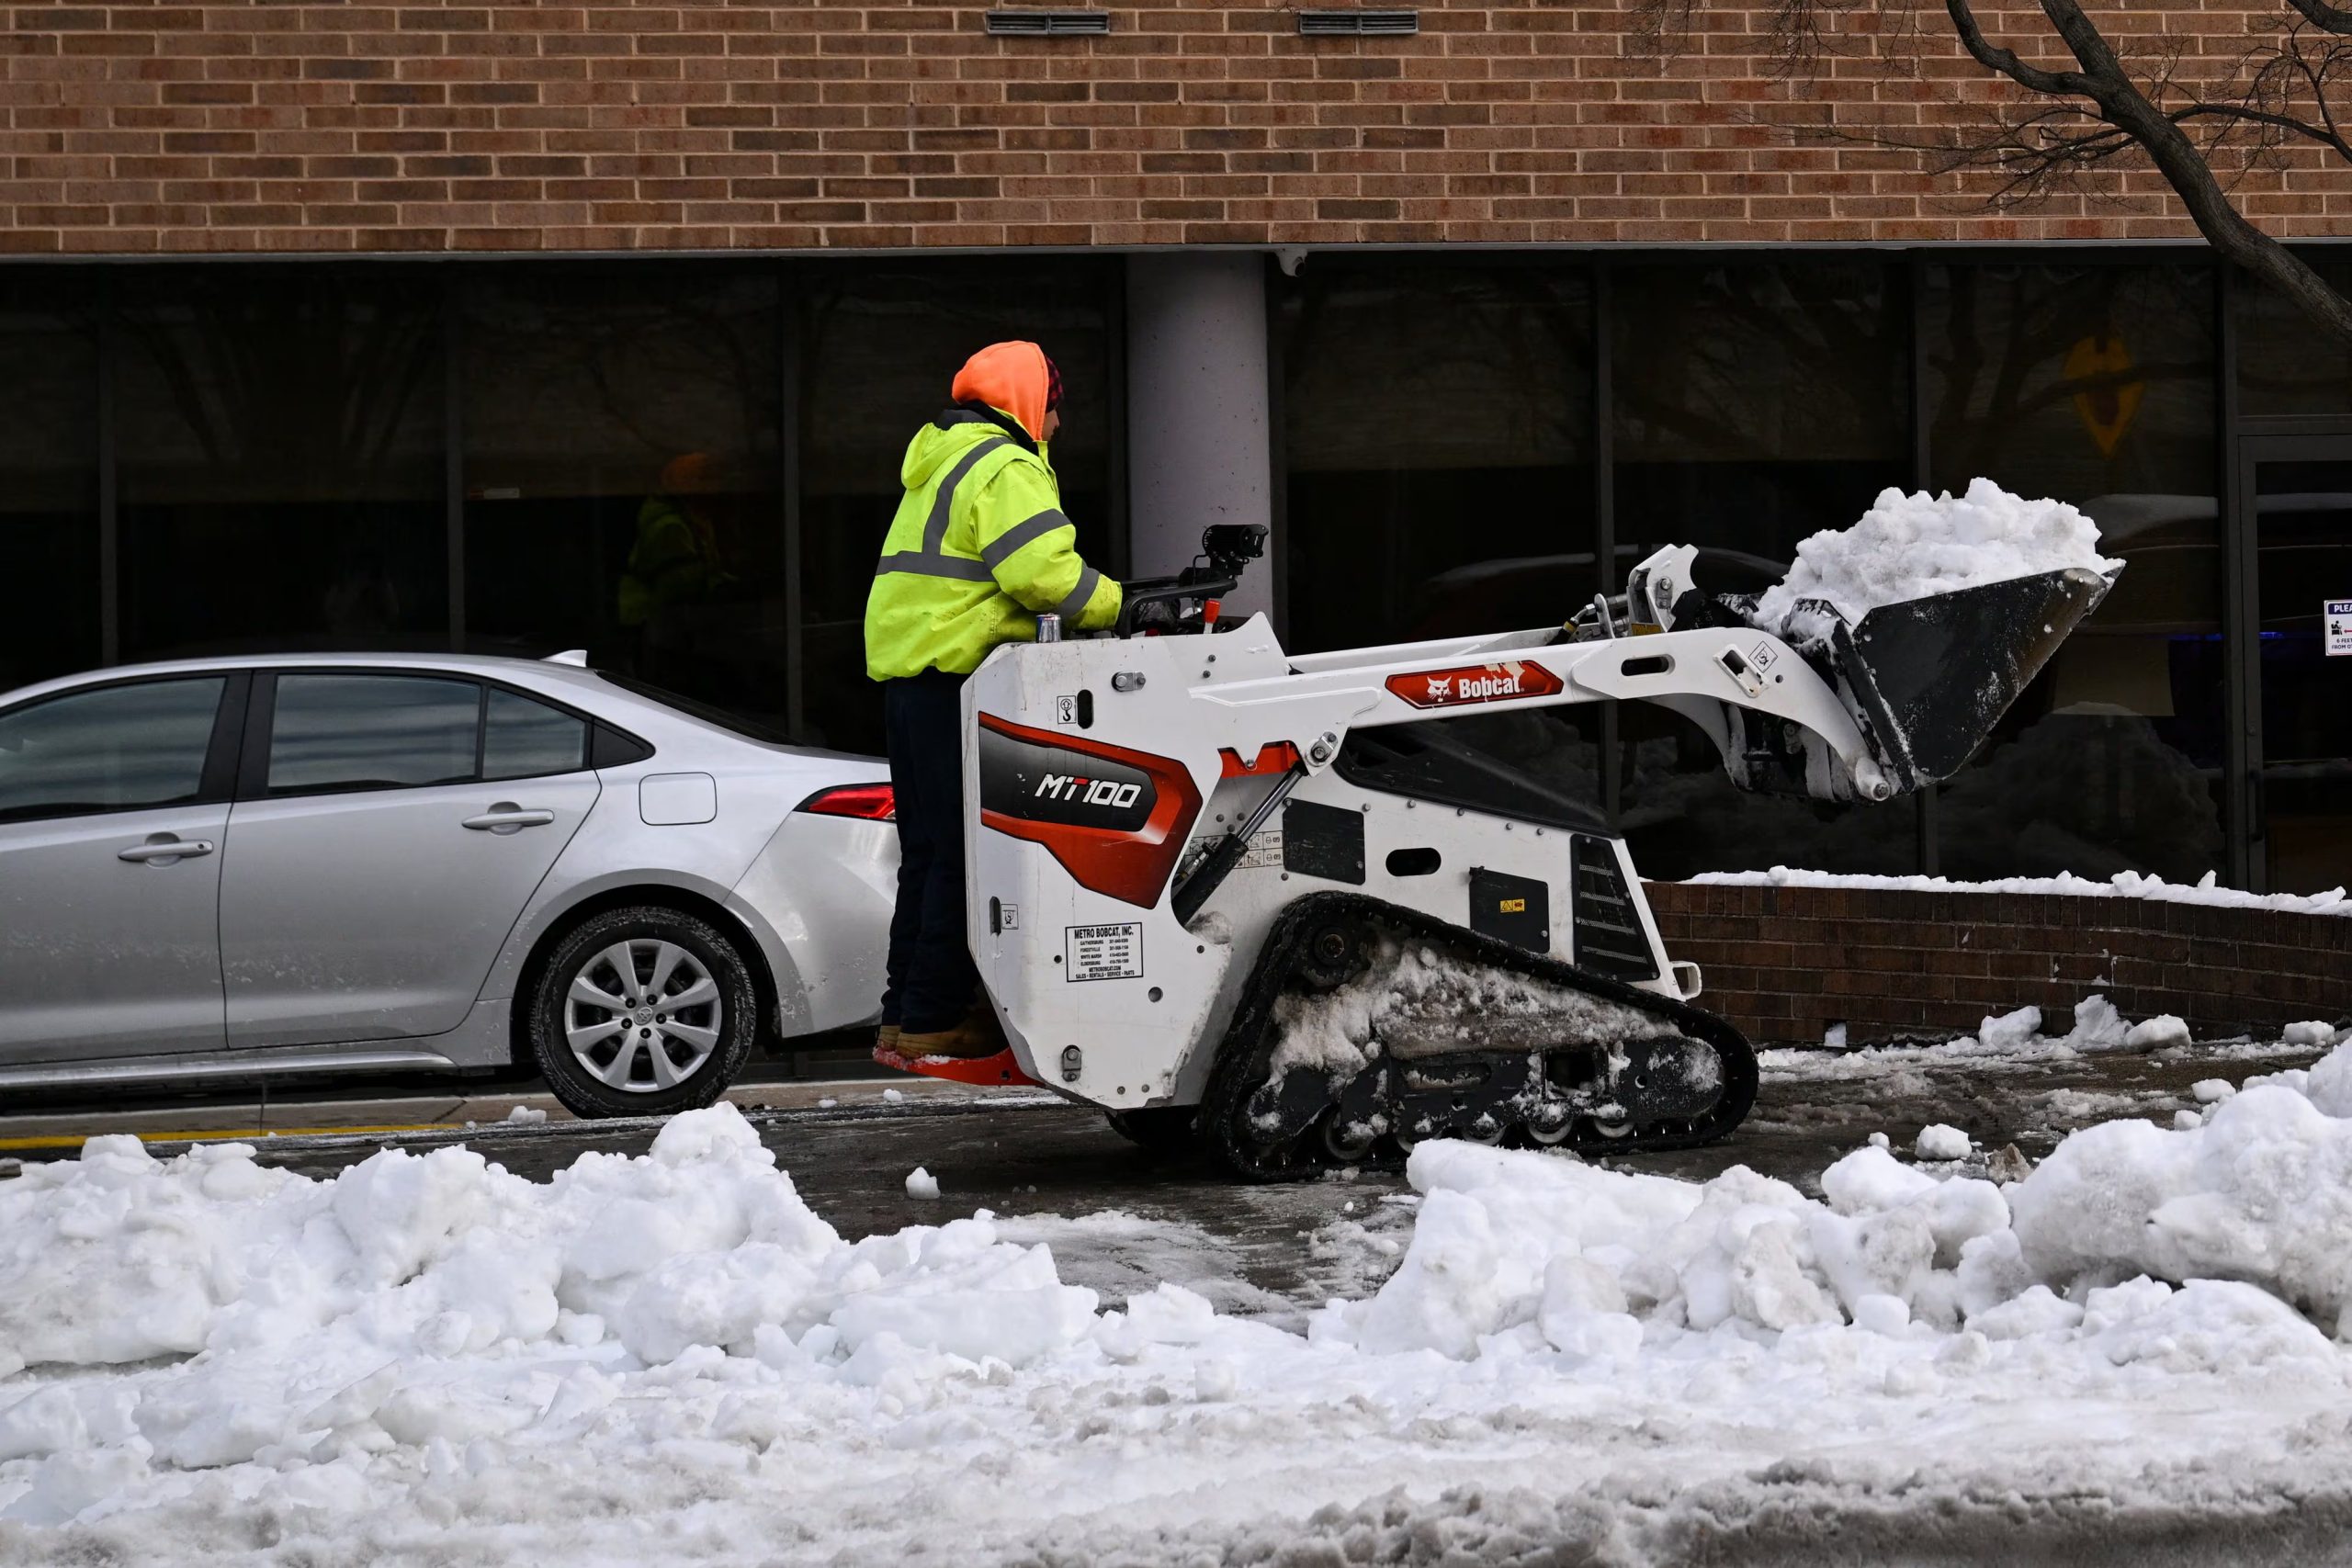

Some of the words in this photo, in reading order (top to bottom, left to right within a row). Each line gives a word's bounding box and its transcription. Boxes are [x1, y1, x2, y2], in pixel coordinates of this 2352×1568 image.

[1458, 676, 1521, 698] Bobcat
[1035, 773, 1142, 808] MT100
[1074, 928, 1095, 939] METRO
[1096, 927, 1121, 938] BOBCAT,
[1122, 925, 1134, 936] INC.
